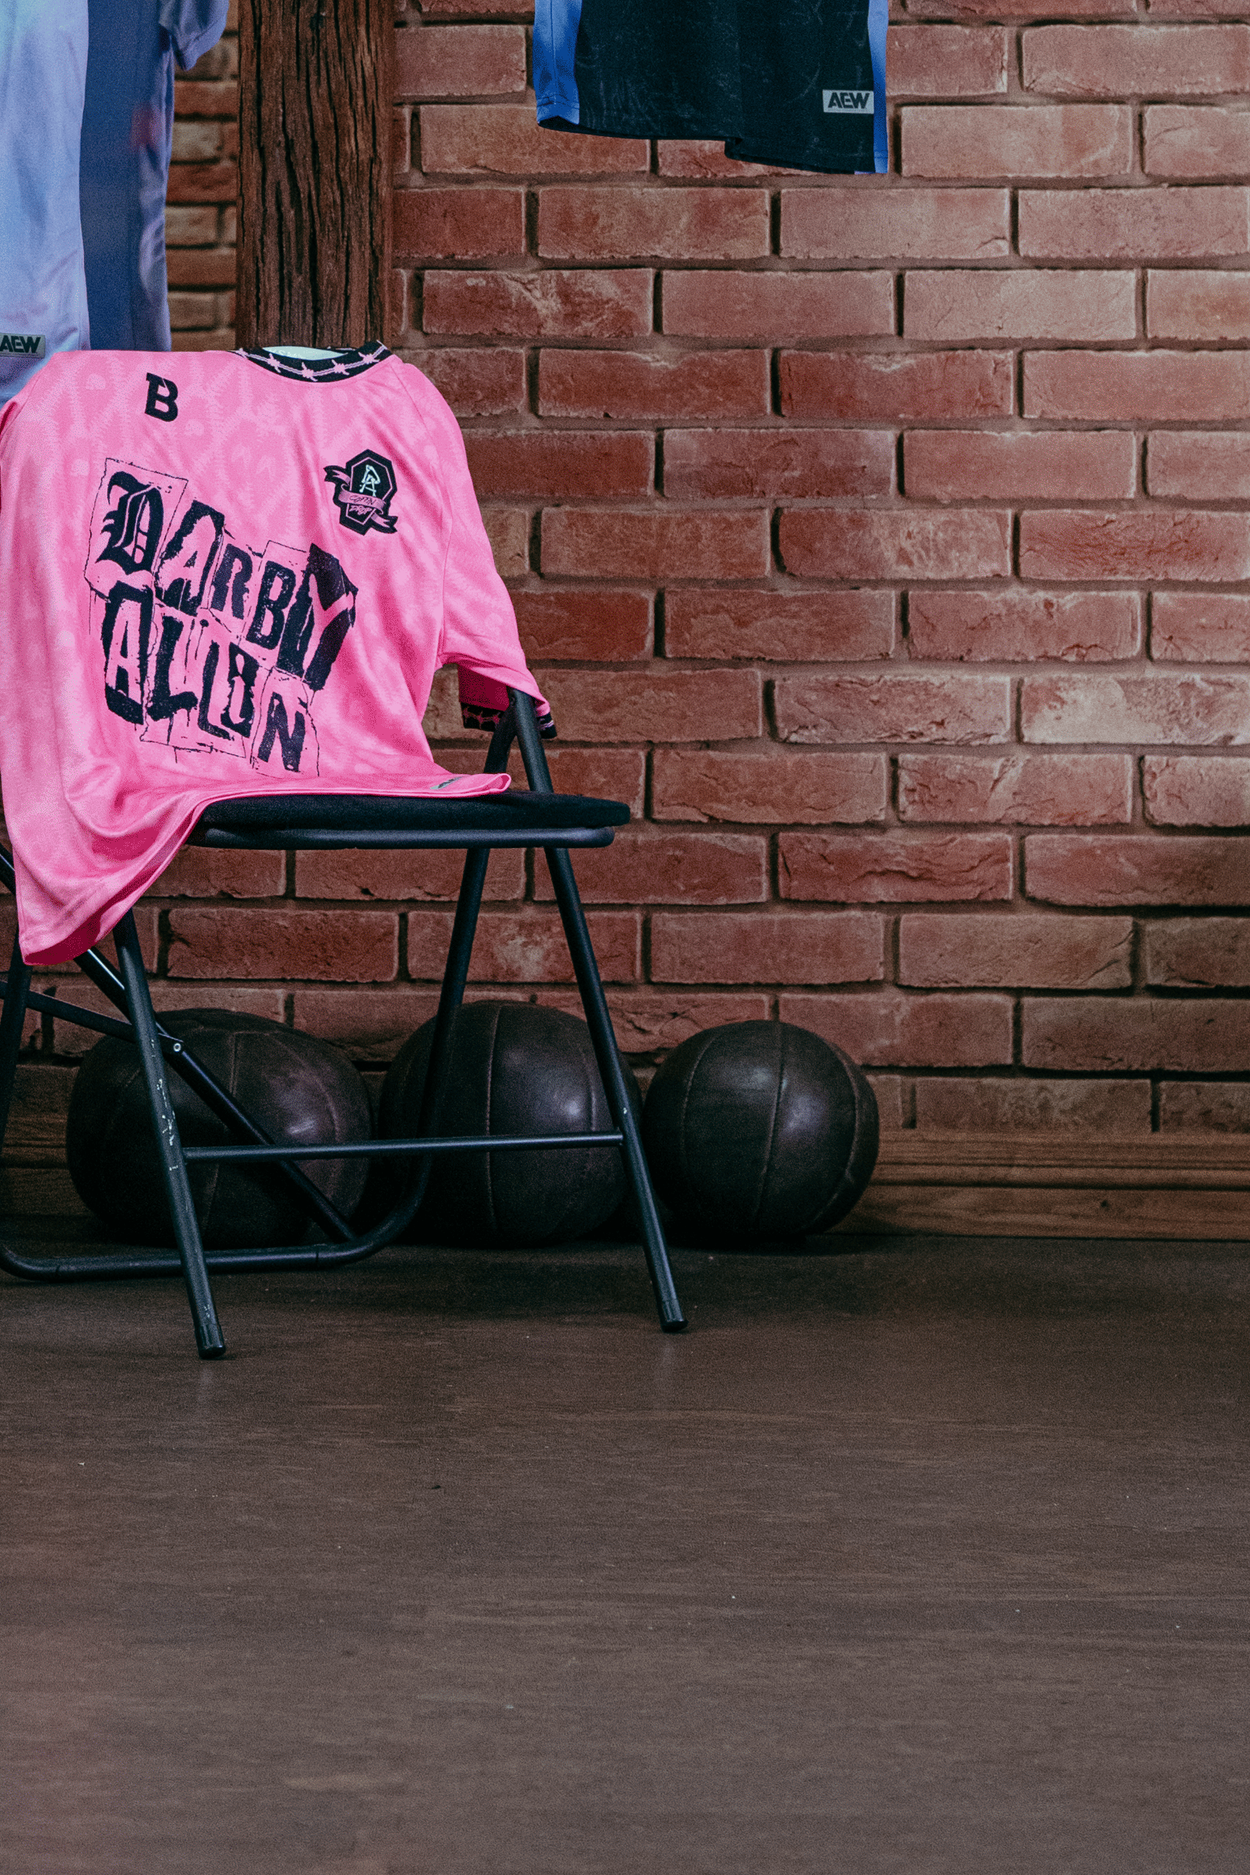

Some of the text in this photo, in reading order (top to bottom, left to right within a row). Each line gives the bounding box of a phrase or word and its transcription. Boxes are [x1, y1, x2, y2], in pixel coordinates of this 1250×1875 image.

[827, 91, 870, 110] AEW
[144, 372, 179, 423] B
[95, 470, 358, 692] DARBY
